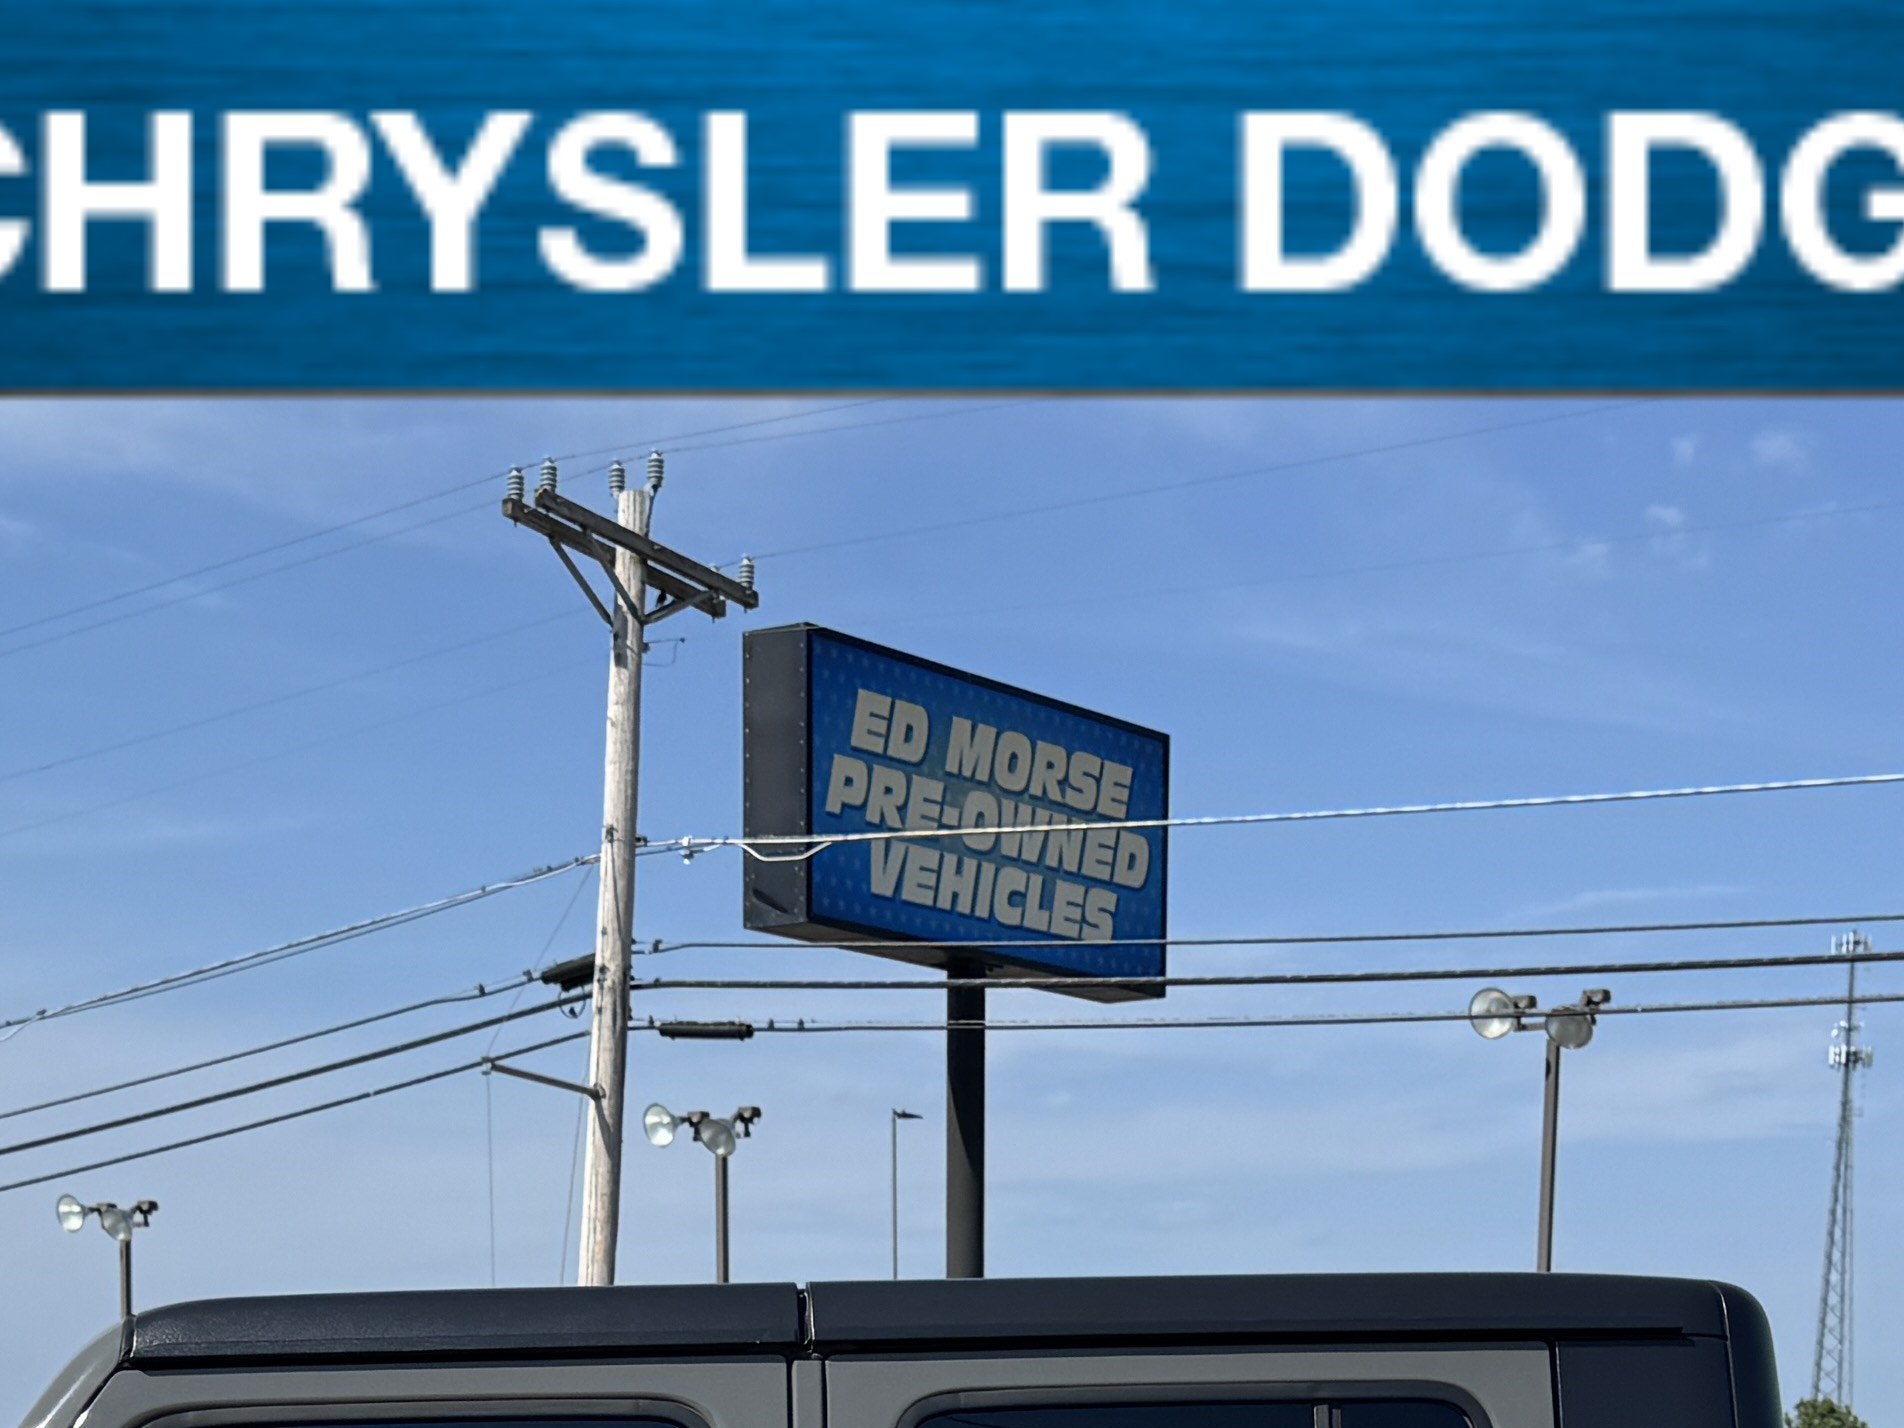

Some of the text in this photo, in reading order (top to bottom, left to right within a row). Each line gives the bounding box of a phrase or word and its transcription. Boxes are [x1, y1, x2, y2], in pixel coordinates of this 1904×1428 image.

[851, 688, 1134, 820] ED MORSE
[825, 753, 1151, 890] PRE-OWNED
[869, 840, 1119, 944] VEHICLES
